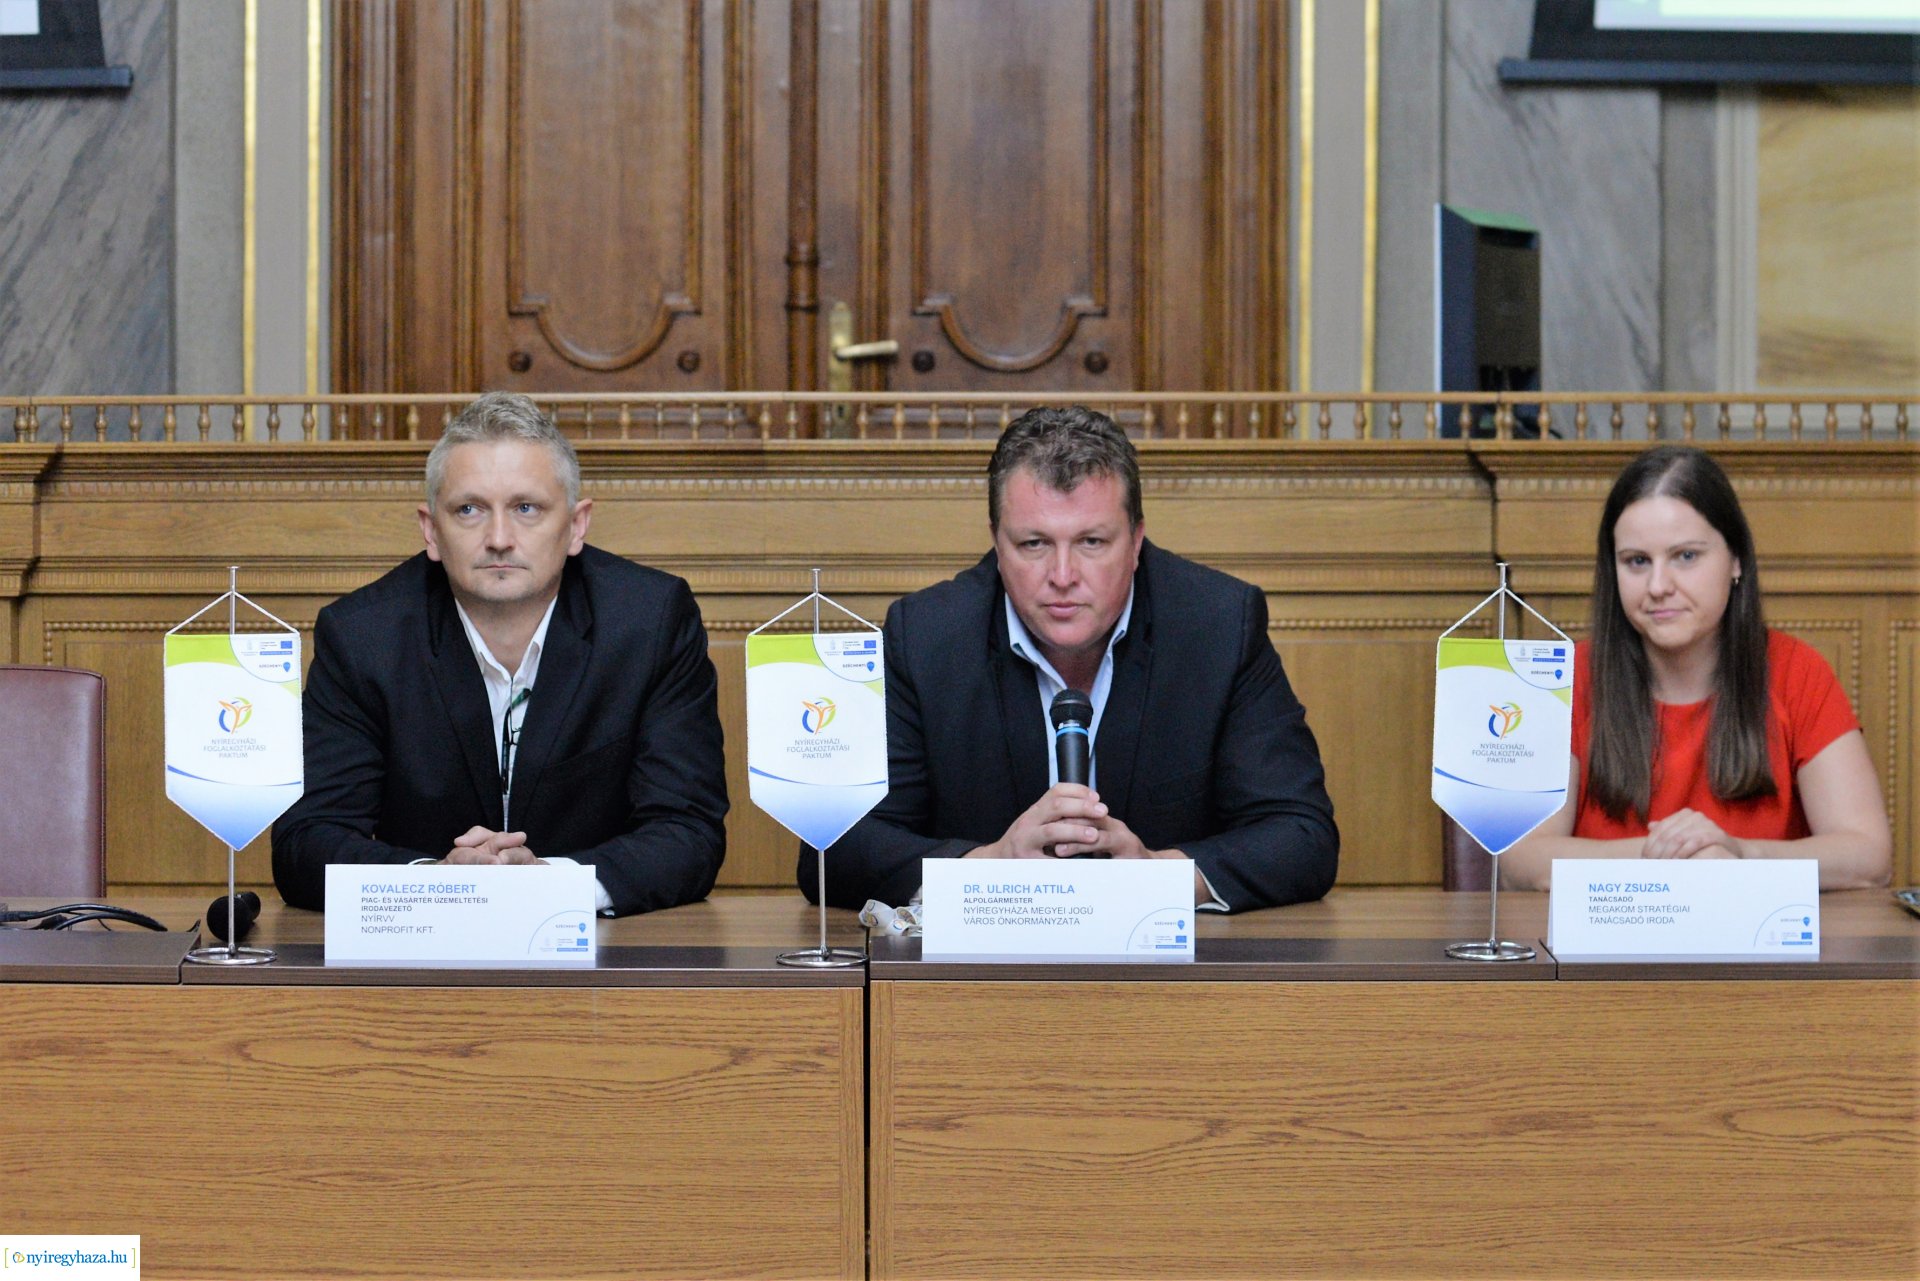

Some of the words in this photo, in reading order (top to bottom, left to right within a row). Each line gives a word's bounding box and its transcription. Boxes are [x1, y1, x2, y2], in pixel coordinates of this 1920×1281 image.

[361, 884, 425, 894] KOVALECZ
[428, 882, 477, 894] RÓBERT
[963, 884, 984, 894] DR.
[987, 884, 1031, 894] ULRICH
[1033, 884, 1075, 894] ATTILA
[1588, 883, 1622, 893] NAGY
[1624, 883, 1670, 893] ZSUZSA
[382, 896, 392, 904] ÉS
[963, 896, 1033, 904] ALPOLGÁRMESTER
[963, 905, 1029, 915] NYÍREGYHÁZA
[1030, 906, 1066, 915] MEGYEI
[1068, 905, 1094, 915] JOGÚ
[1588, 905, 1635, 913] MEGAKOM
[1637, 904, 1690, 913] STRATÉGIAI
[361, 913, 395, 923] NYÍRVV
[963, 916, 996, 925] VÁROS
[997, 916, 1081, 925] ÖNKORMÁNYZATA
[1589, 915, 1645, 924] TANÁCSADÓ
[1646, 916, 1675, 924] IRODA
[361, 926, 414, 934] NONPROFIT
